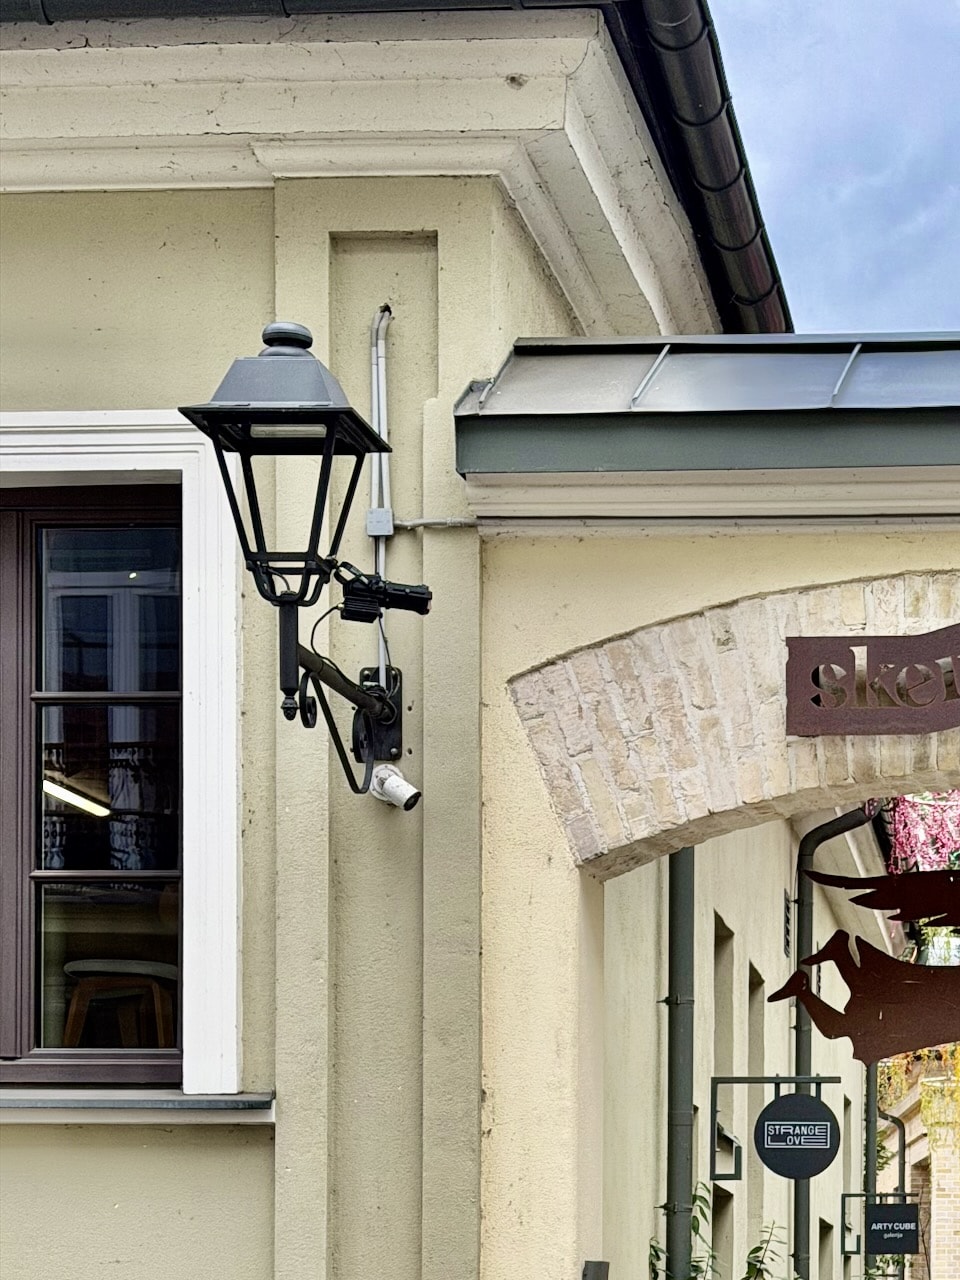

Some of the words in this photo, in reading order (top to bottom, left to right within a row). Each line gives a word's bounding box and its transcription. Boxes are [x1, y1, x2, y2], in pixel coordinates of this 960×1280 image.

[768, 1125, 827, 1136] STRANGE
[768, 1135, 827, 1146] LOVE
[871, 1222, 893, 1230] ARTY
[893, 1222, 916, 1230] CUBE
